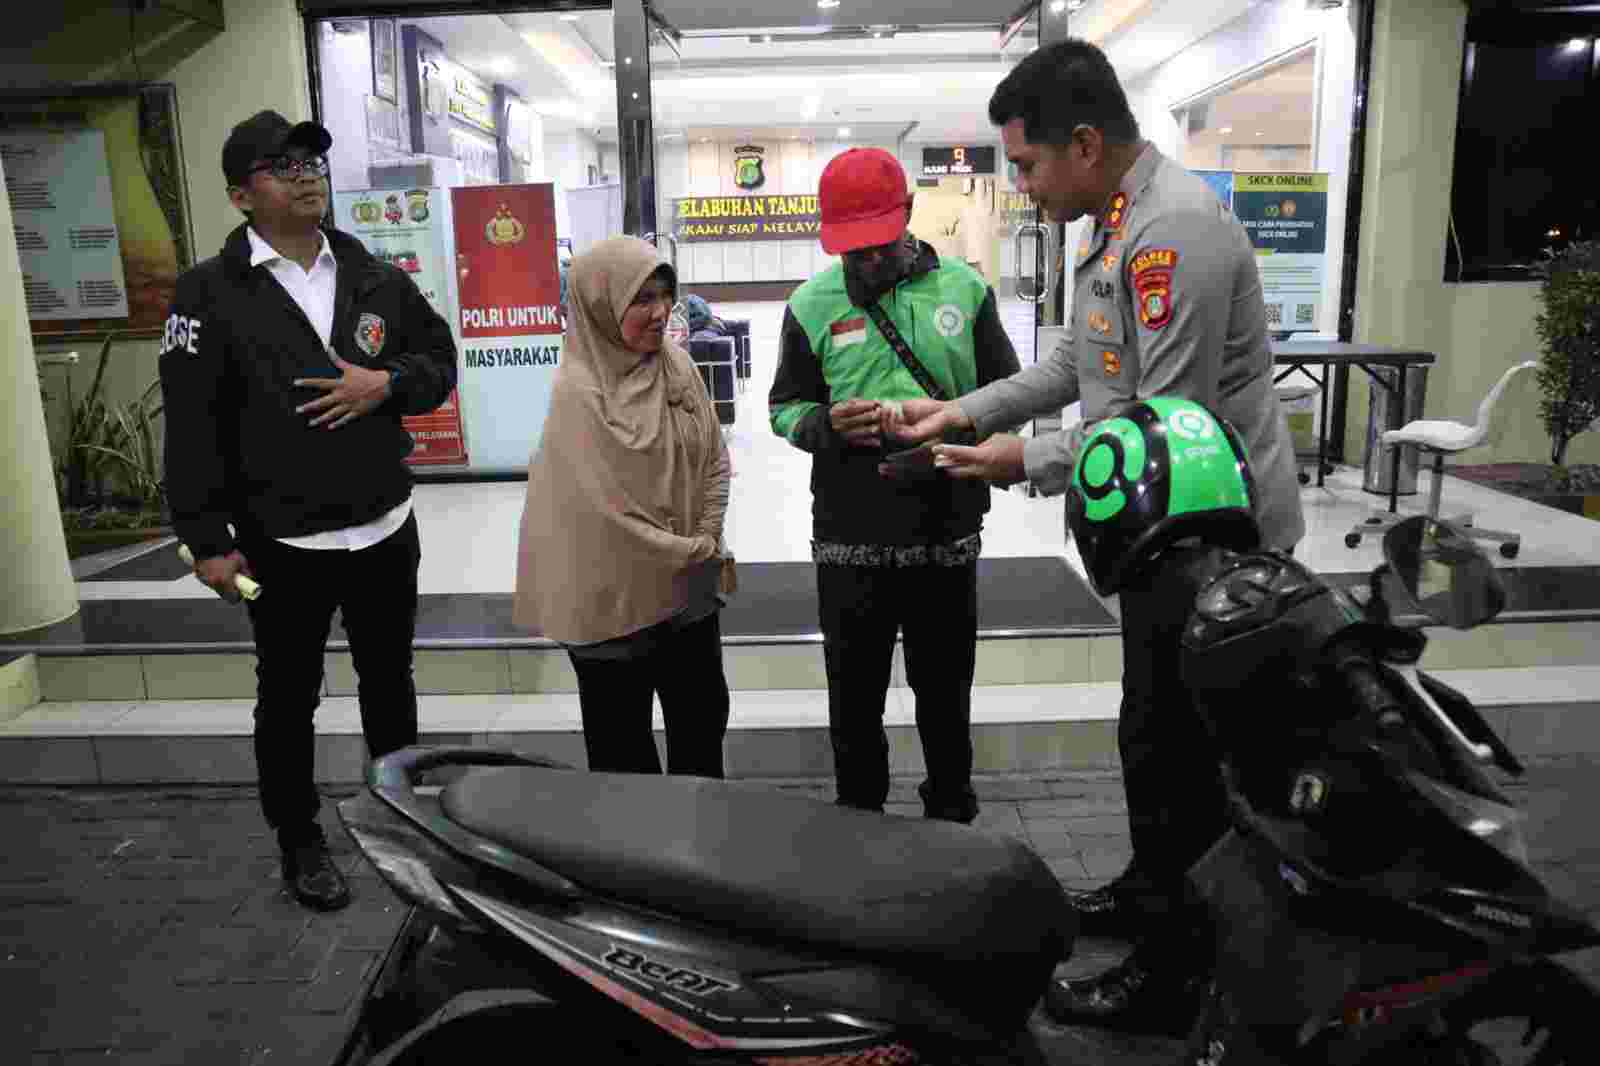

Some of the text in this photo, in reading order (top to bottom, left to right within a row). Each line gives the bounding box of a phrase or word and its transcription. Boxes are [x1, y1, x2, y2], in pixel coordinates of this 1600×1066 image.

[1247, 175, 1312, 185] SKCK ONLINE
[462, 304, 558, 328] POLRI UNTUK
[464, 345, 560, 368] MASYARAKAT
